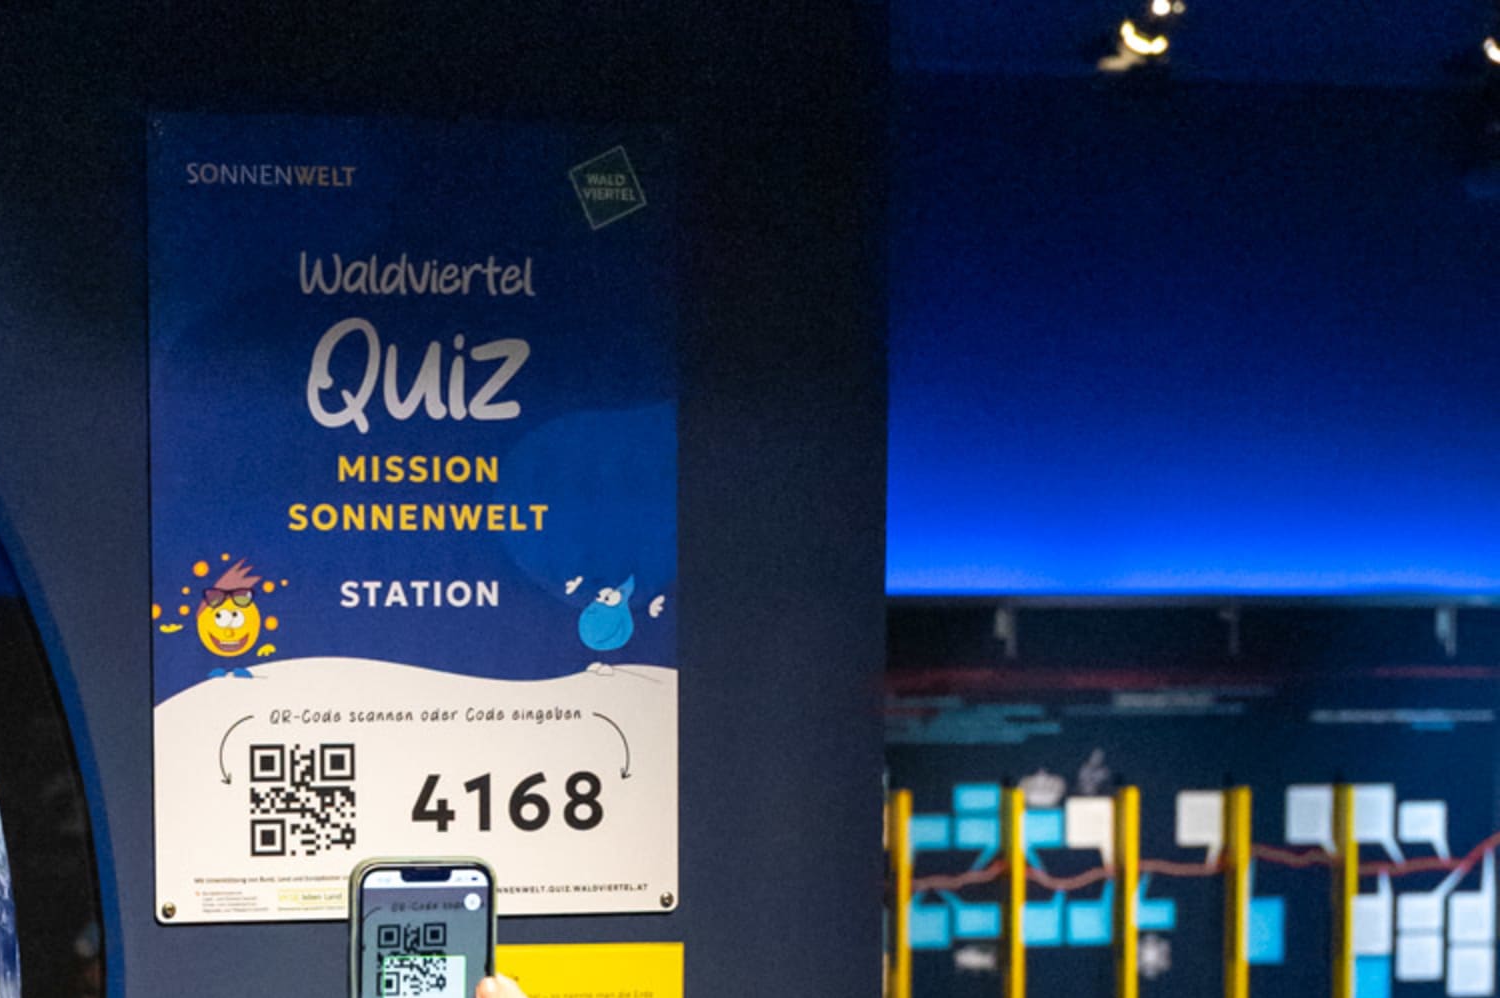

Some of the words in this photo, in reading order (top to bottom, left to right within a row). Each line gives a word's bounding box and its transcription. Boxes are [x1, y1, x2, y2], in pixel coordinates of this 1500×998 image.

[186, 162, 358, 187] SONNENWELT
[585, 172, 626, 187] WALD
[582, 186, 636, 202] VIERTEL
[300, 251, 536, 297] Waldviertel
[306, 317, 531, 434] Quiz
[337, 455, 500, 483] MISSION
[287, 504, 550, 531] SONNENWELT
[339, 581, 501, 608] STATION
[269, 708, 342, 726] QR-Code
[348, 709, 414, 723] scannen
[419, 708, 458, 722] oder
[465, 707, 505, 722] Code
[511, 706, 582, 725] eingeben
[410, 770, 605, 833] 4168
